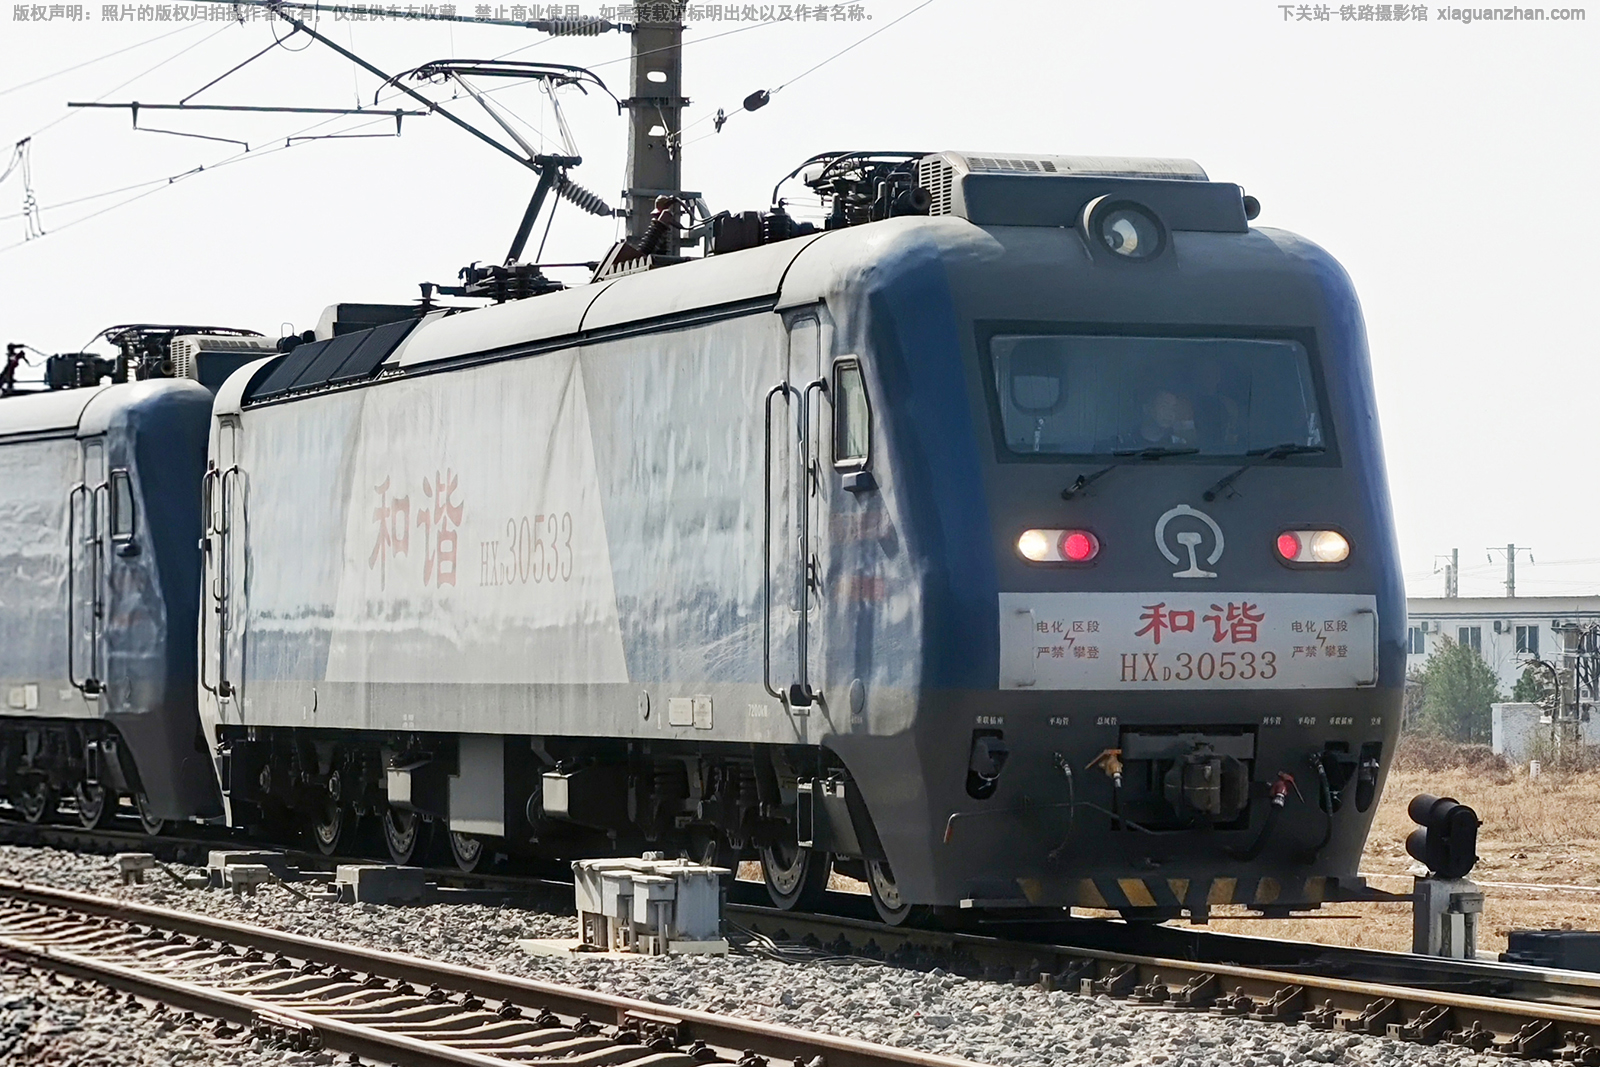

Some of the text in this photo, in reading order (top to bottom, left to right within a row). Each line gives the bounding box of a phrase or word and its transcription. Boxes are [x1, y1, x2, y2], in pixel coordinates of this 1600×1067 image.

[368, 467, 465, 592] 和谐
[479, 511, 574, 588] HXD30533
[1134, 602, 1266, 645] 和谐
[1119, 651, 1278, 682] HXD30533
